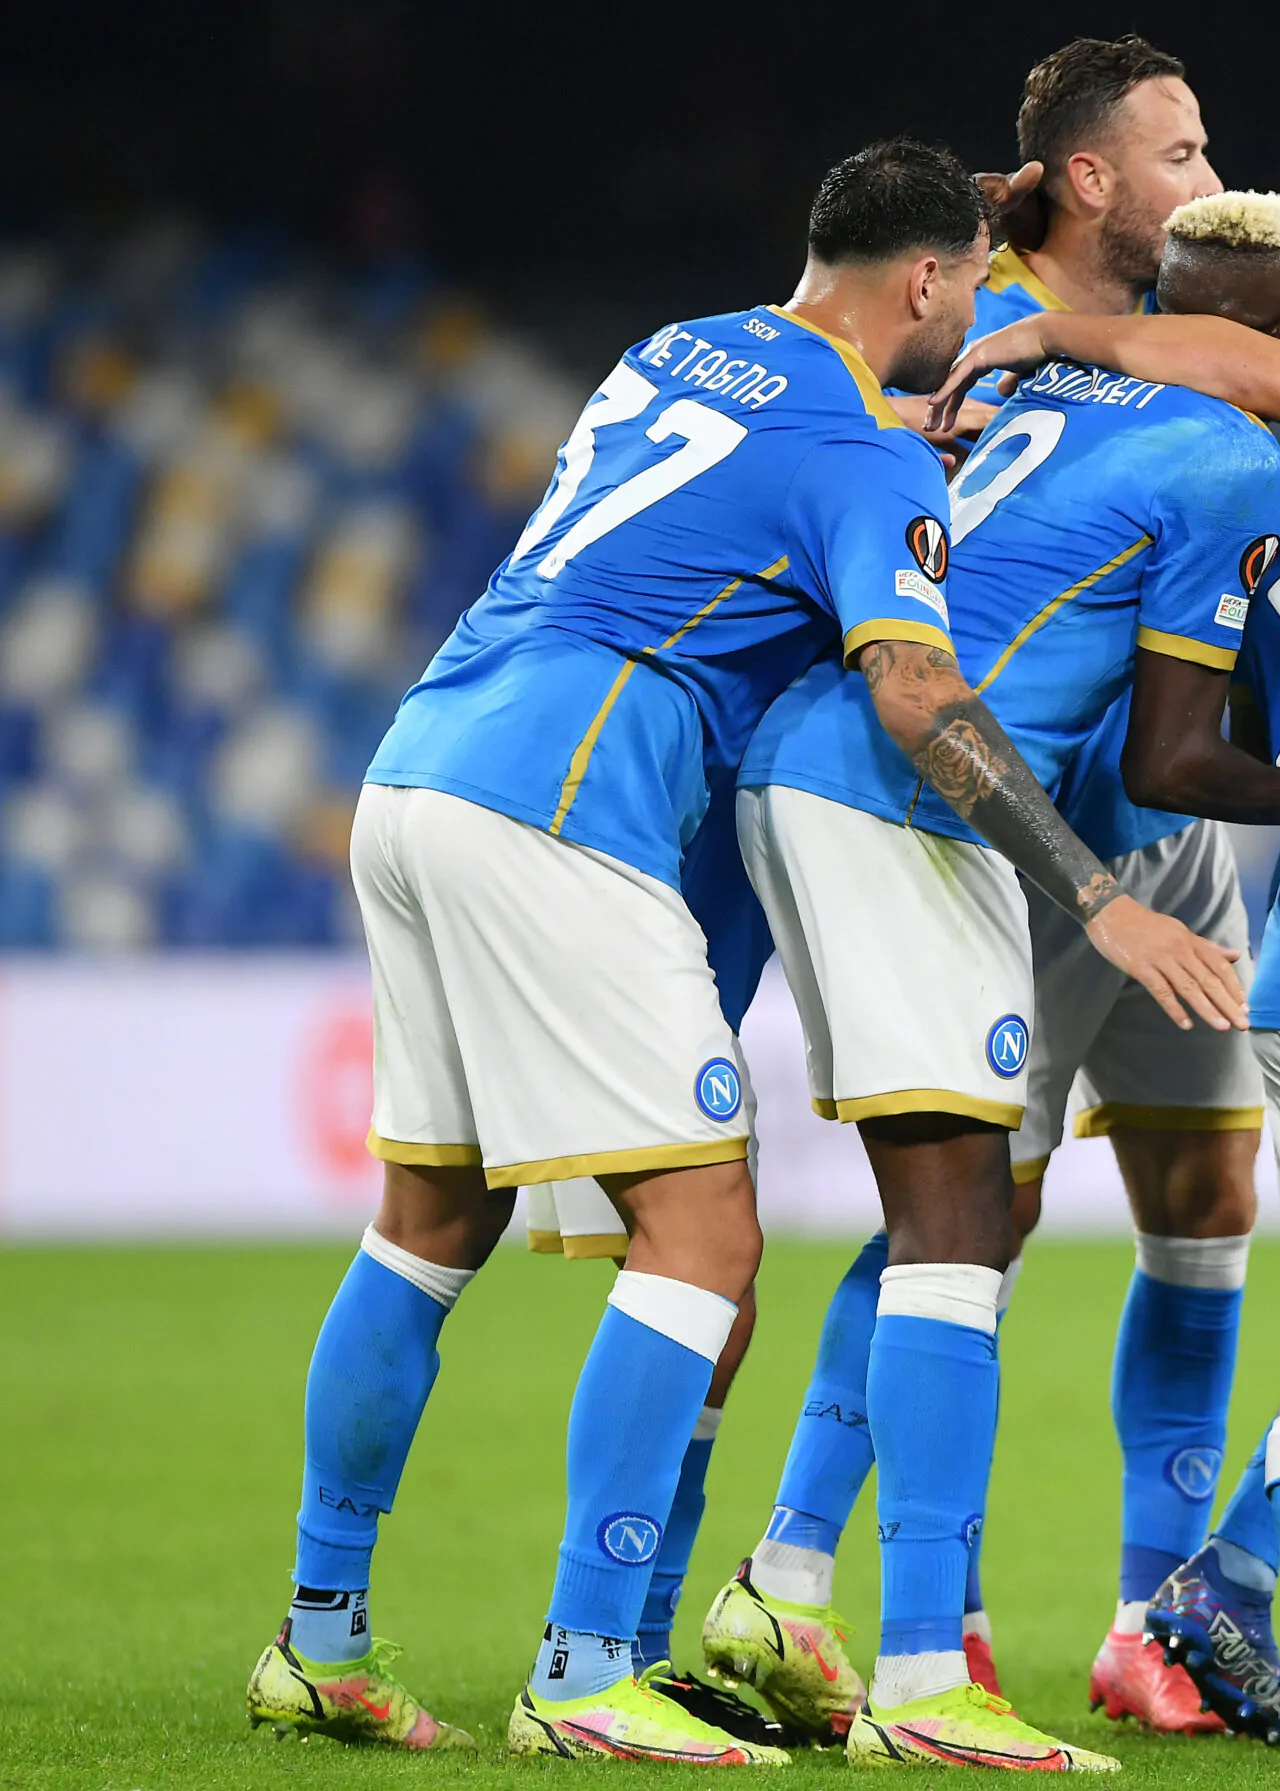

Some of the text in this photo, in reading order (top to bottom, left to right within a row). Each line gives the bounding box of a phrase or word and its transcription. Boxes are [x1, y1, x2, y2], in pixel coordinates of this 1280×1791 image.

[742, 317, 782, 342] SSCN
[640, 323, 789, 410] PETAGNA
[1000, 1031, 1023, 1063] N
[709, 1073, 731, 1107] N
[805, 1401, 868, 1428] EA7
[318, 1485, 378, 1517] EA7
[615, 1524, 652, 1554] N
